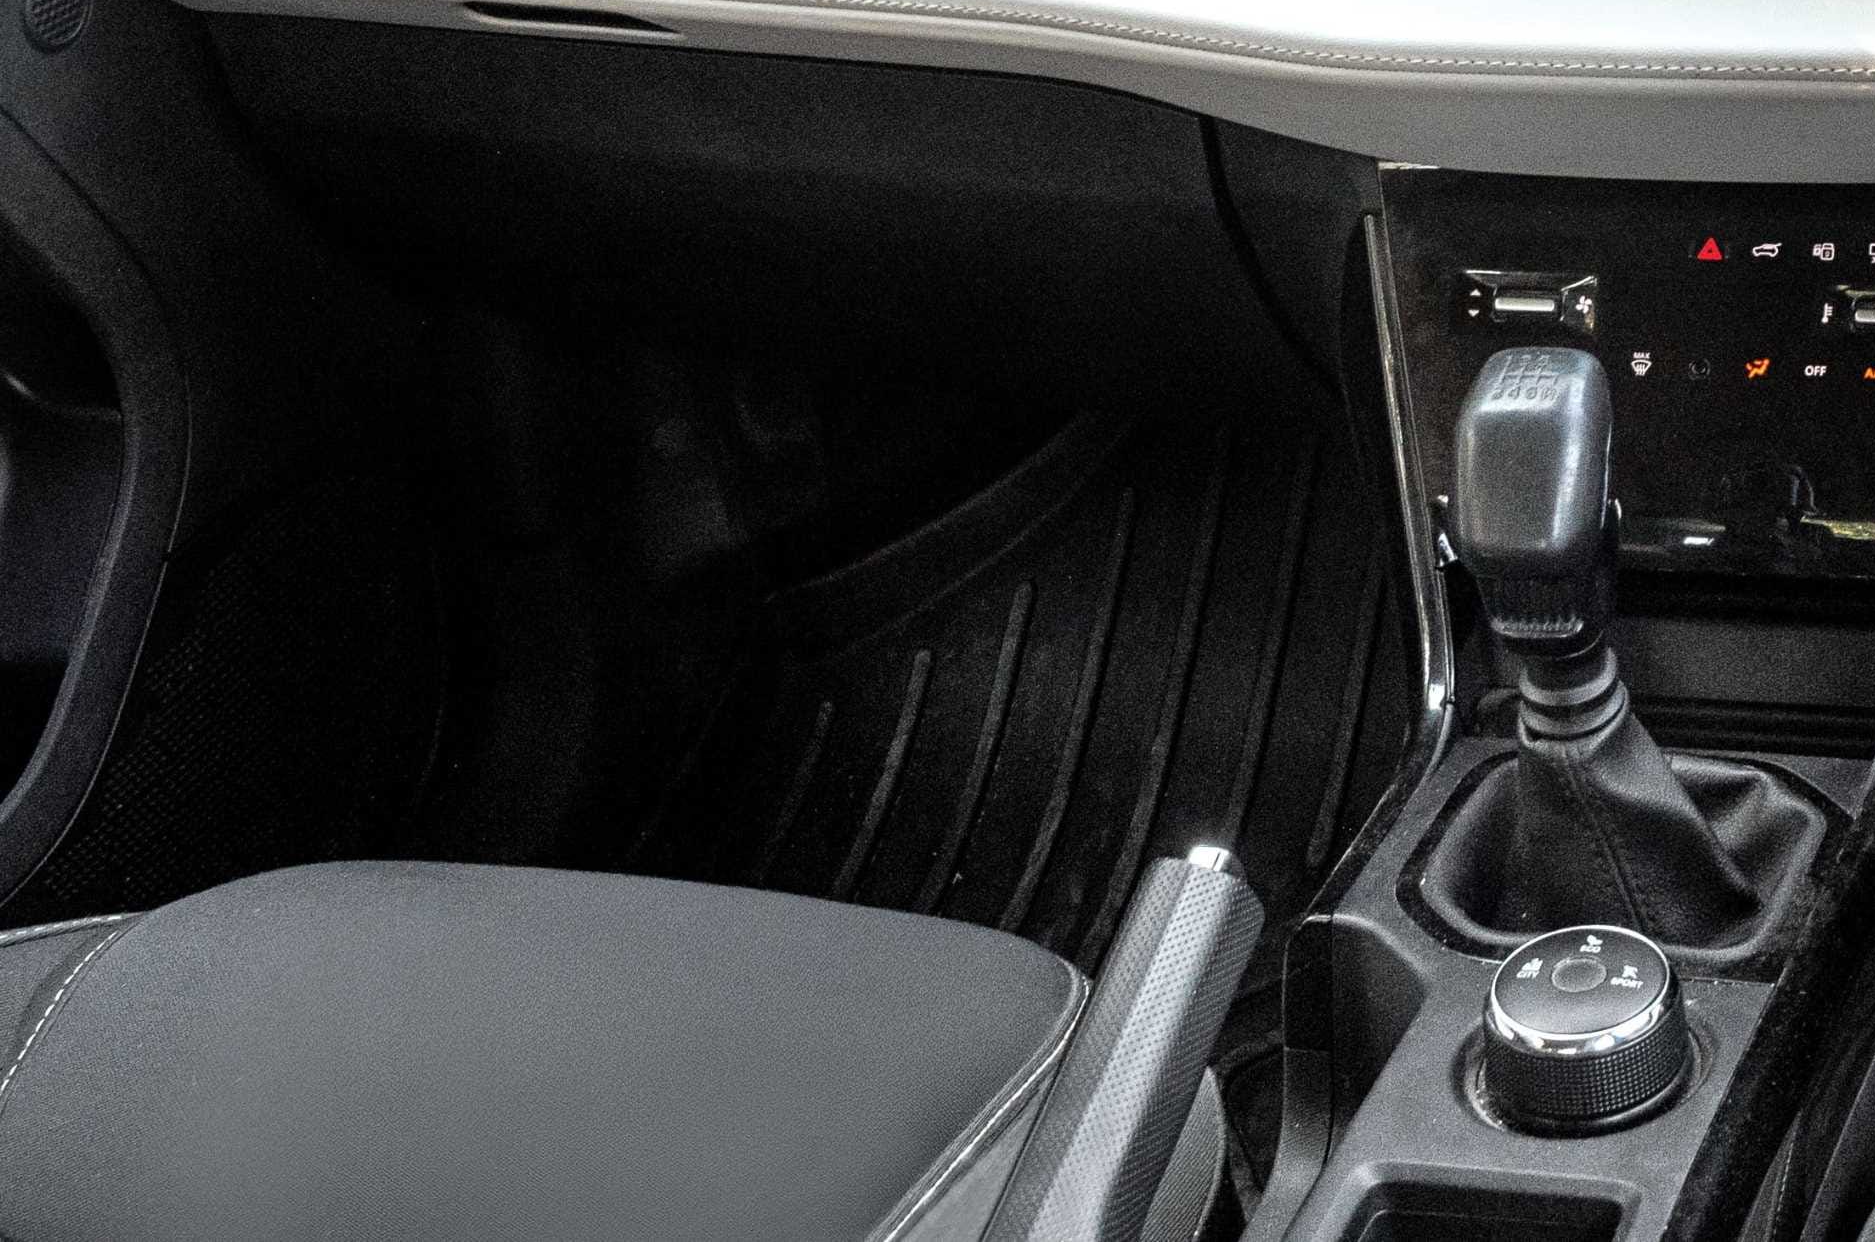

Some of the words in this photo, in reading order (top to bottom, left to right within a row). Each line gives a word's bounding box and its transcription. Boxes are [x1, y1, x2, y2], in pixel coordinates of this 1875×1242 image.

[1633, 351, 1651, 359] MAX
[1804, 365, 1827, 377] OFF
[1580, 944, 1602, 954] ECO
[1516, 969, 1541, 979] CITY
[1610, 976, 1645, 989] SPORT
